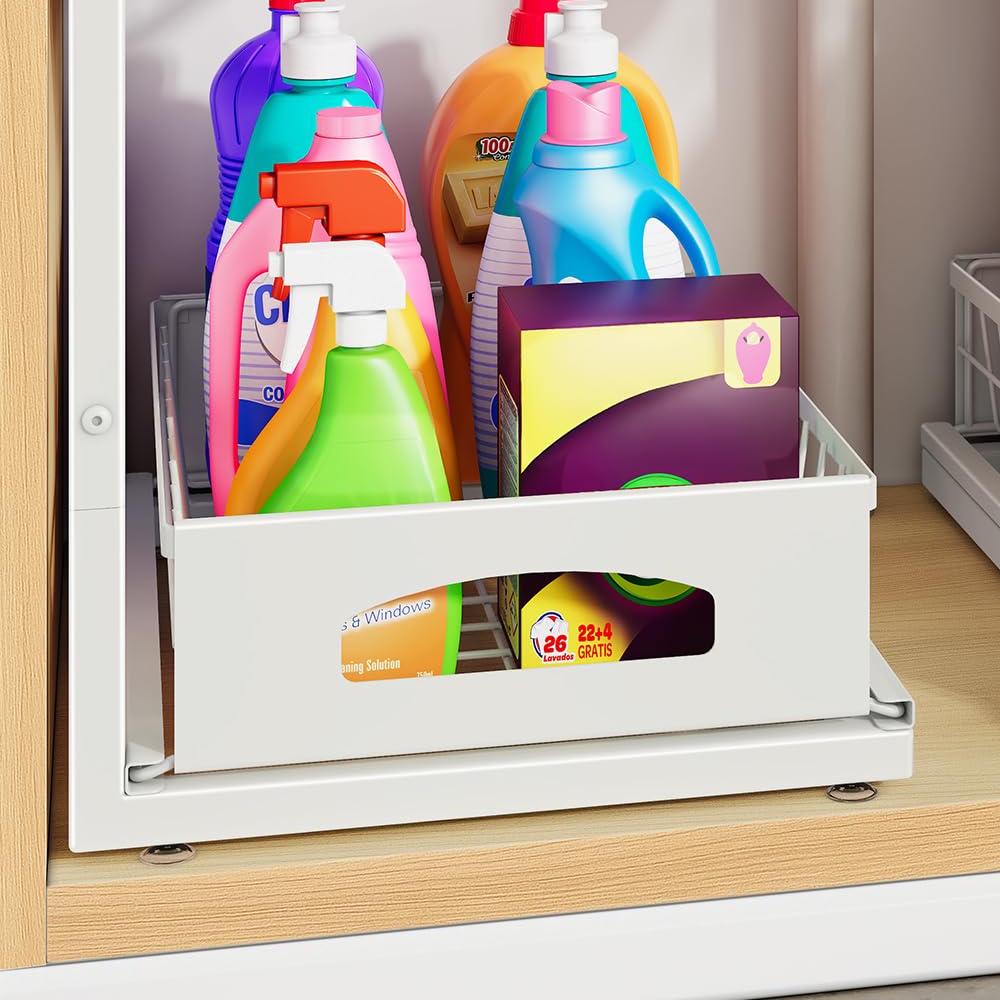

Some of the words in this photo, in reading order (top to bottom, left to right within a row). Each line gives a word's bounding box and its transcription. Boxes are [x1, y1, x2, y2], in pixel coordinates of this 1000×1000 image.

[351, 615, 361, 628] &
[364, 599, 432, 625] Windows
[578, 622, 613, 642] 22+4
[543, 634, 568, 653] 26
[577, 642, 613, 659] GRATIS
[366, 658, 401, 672] Solution
[543, 653, 575, 662] Lavados
